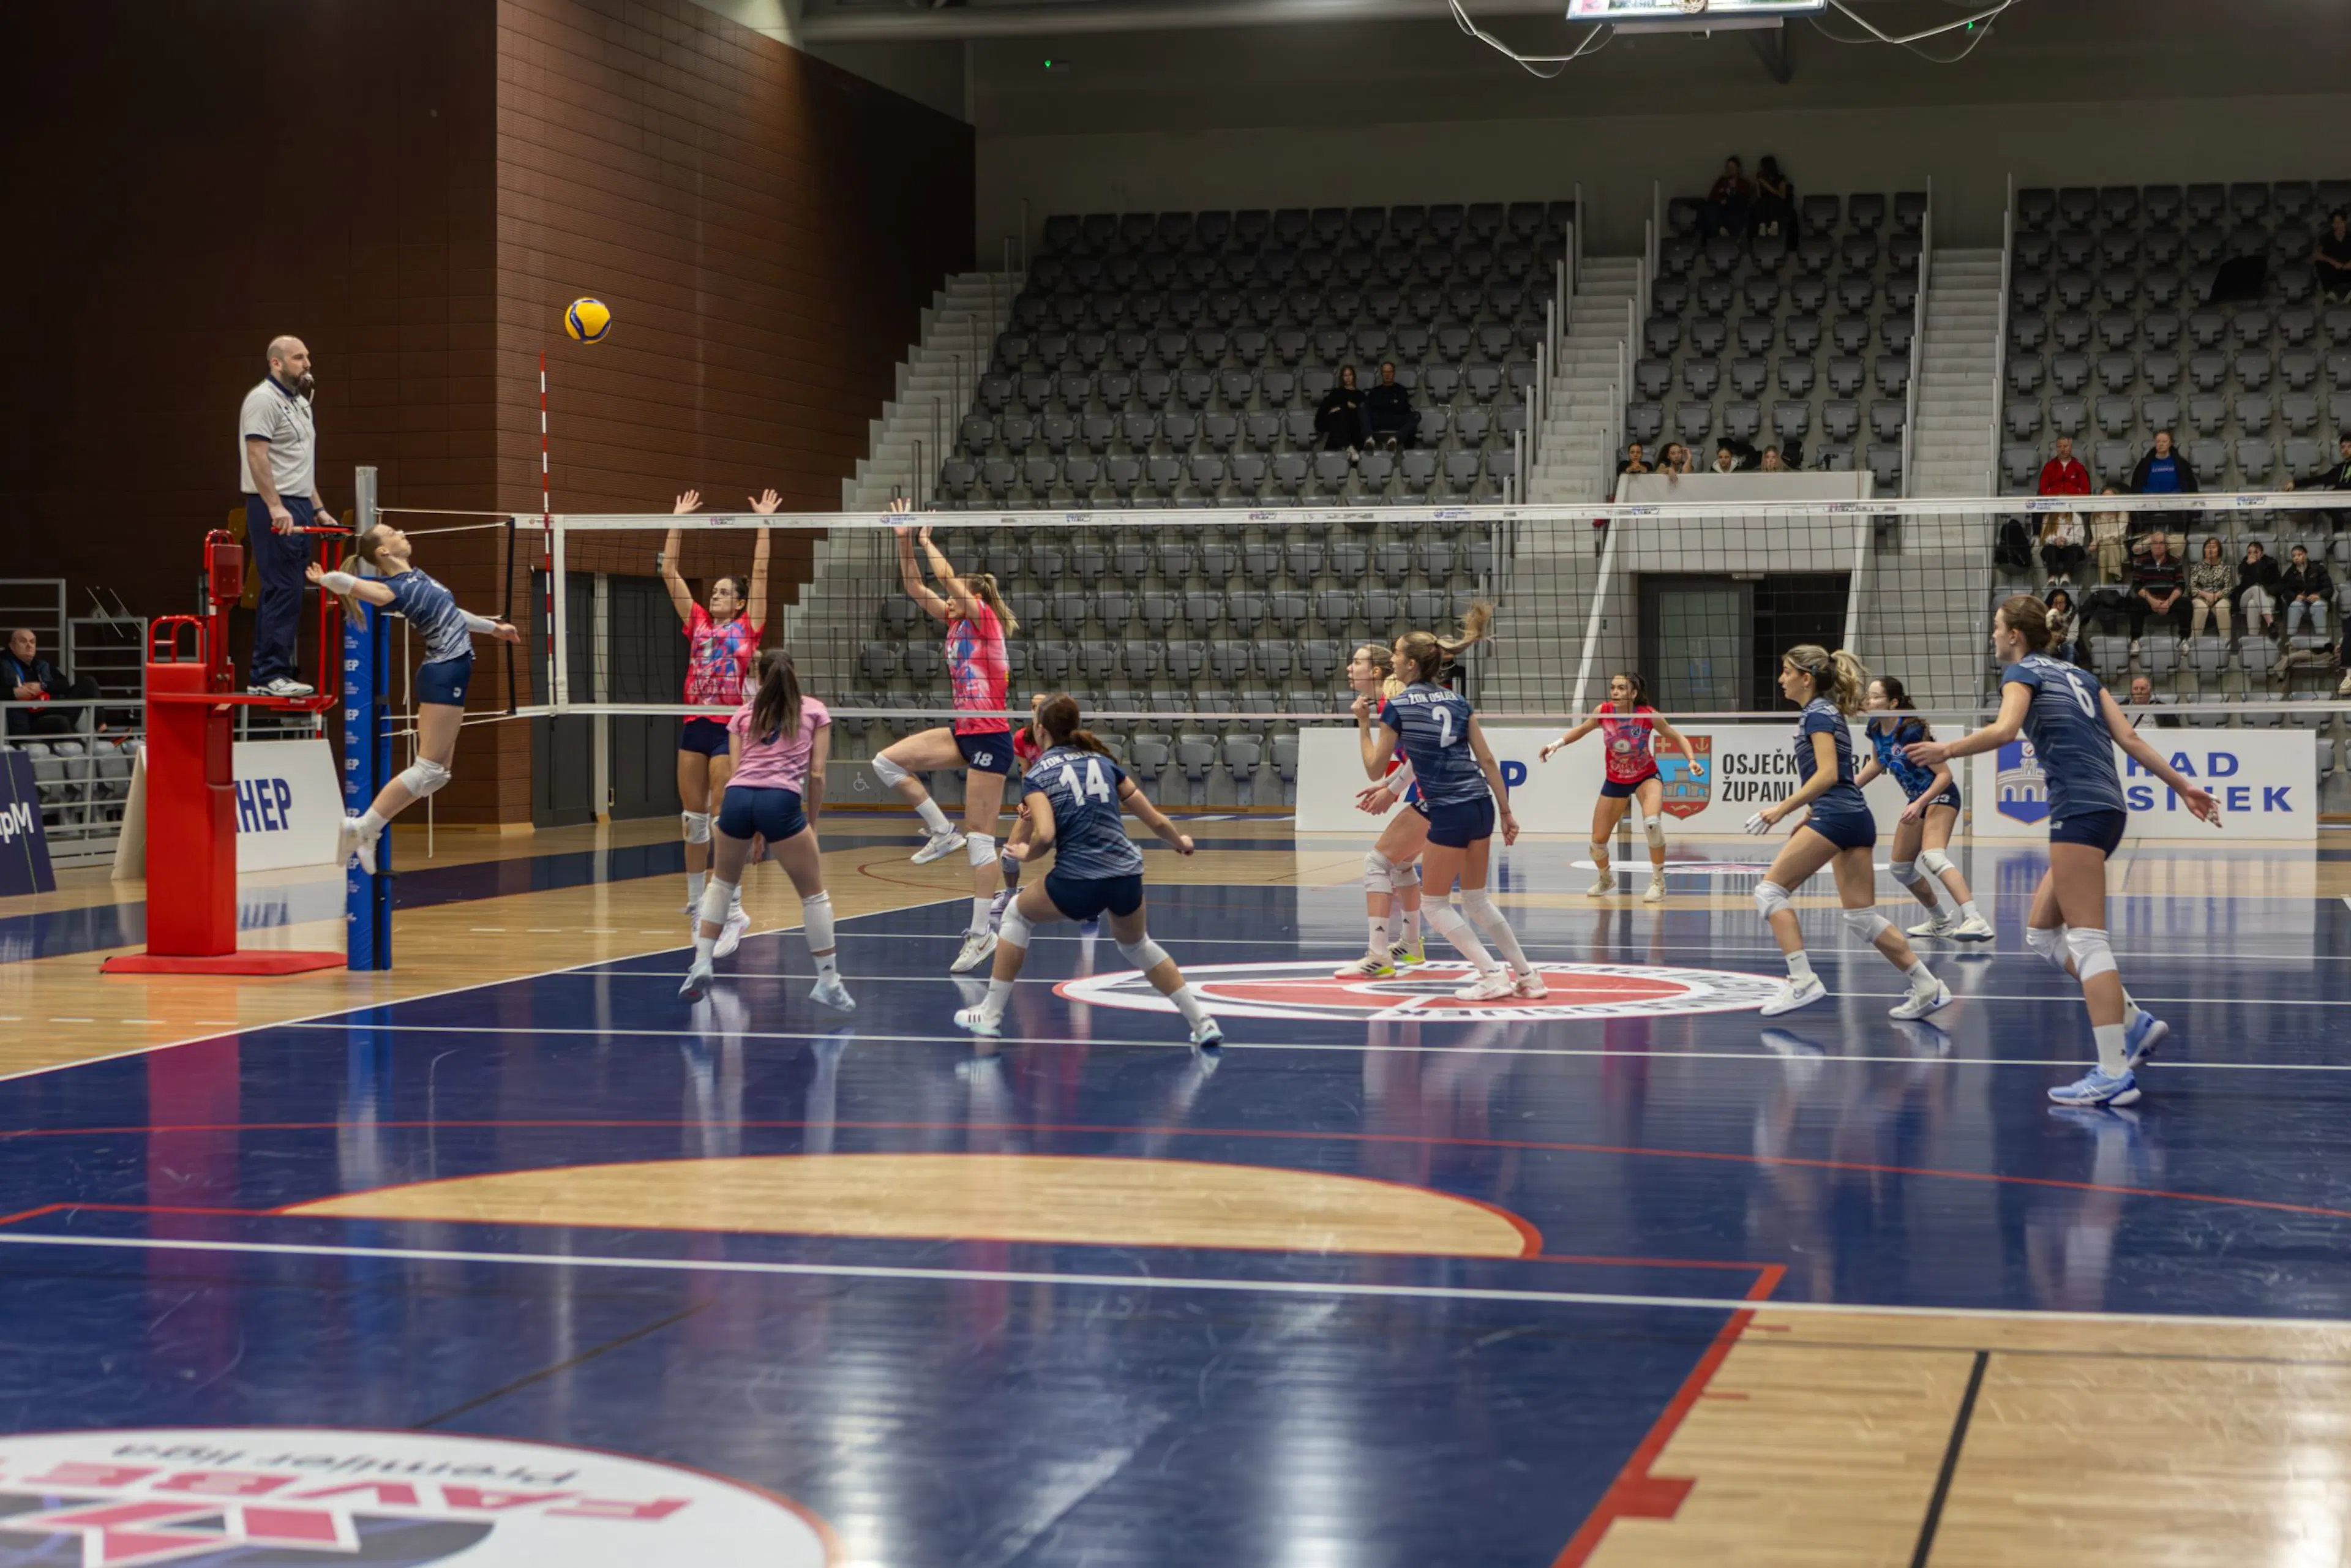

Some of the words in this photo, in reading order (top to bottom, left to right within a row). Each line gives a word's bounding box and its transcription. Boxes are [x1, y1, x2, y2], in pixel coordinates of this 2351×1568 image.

[2066, 672, 2096, 718] 6
[1432, 705, 1457, 748] 2
[973, 751, 993, 767] 18
[1722, 749, 1798, 775] OSJEČK
[2126, 752, 2239, 778] RAD
[1059, 759, 1110, 806] 14
[1722, 776, 1794, 802] ŽUPANI
[2127, 786, 2294, 812] SIEK
[233, 778, 291, 833] HEP
[0, 1457, 693, 1522] FAVBE
